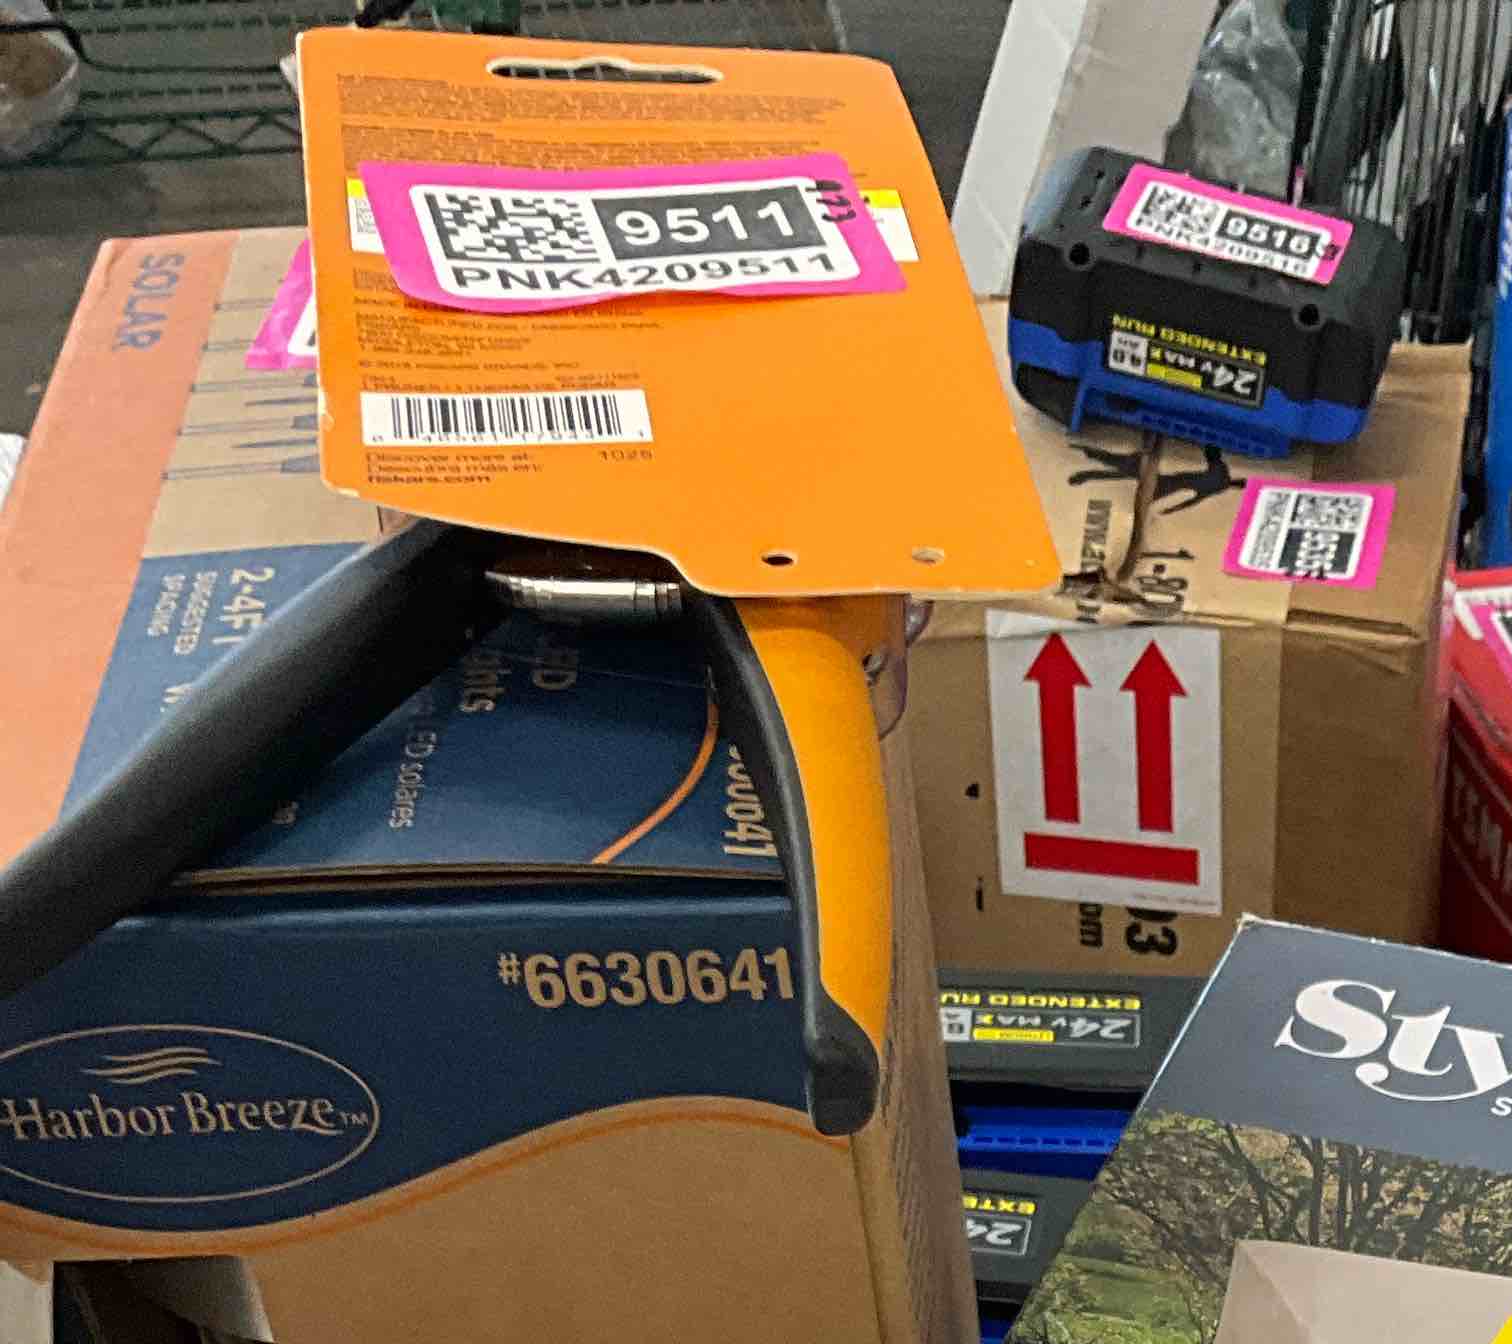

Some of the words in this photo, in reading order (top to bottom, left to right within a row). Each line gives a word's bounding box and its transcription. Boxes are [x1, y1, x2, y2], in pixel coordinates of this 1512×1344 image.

[613, 201, 798, 245] 9511
[452, 253, 835, 293] PNK4209511
[112, 251, 186, 353] SOLAR
[497, 946, 795, 1008] #6630641
[940, 992, 981, 1006] RU
[989, 993, 1141, 1010] EXTENDED
[976, 1013, 1041, 1027] MAX
[2, 1095, 174, 1142] Harbor
[182, 1091, 344, 1138] Breeze
[963, 1195, 1037, 1215] EXTE
